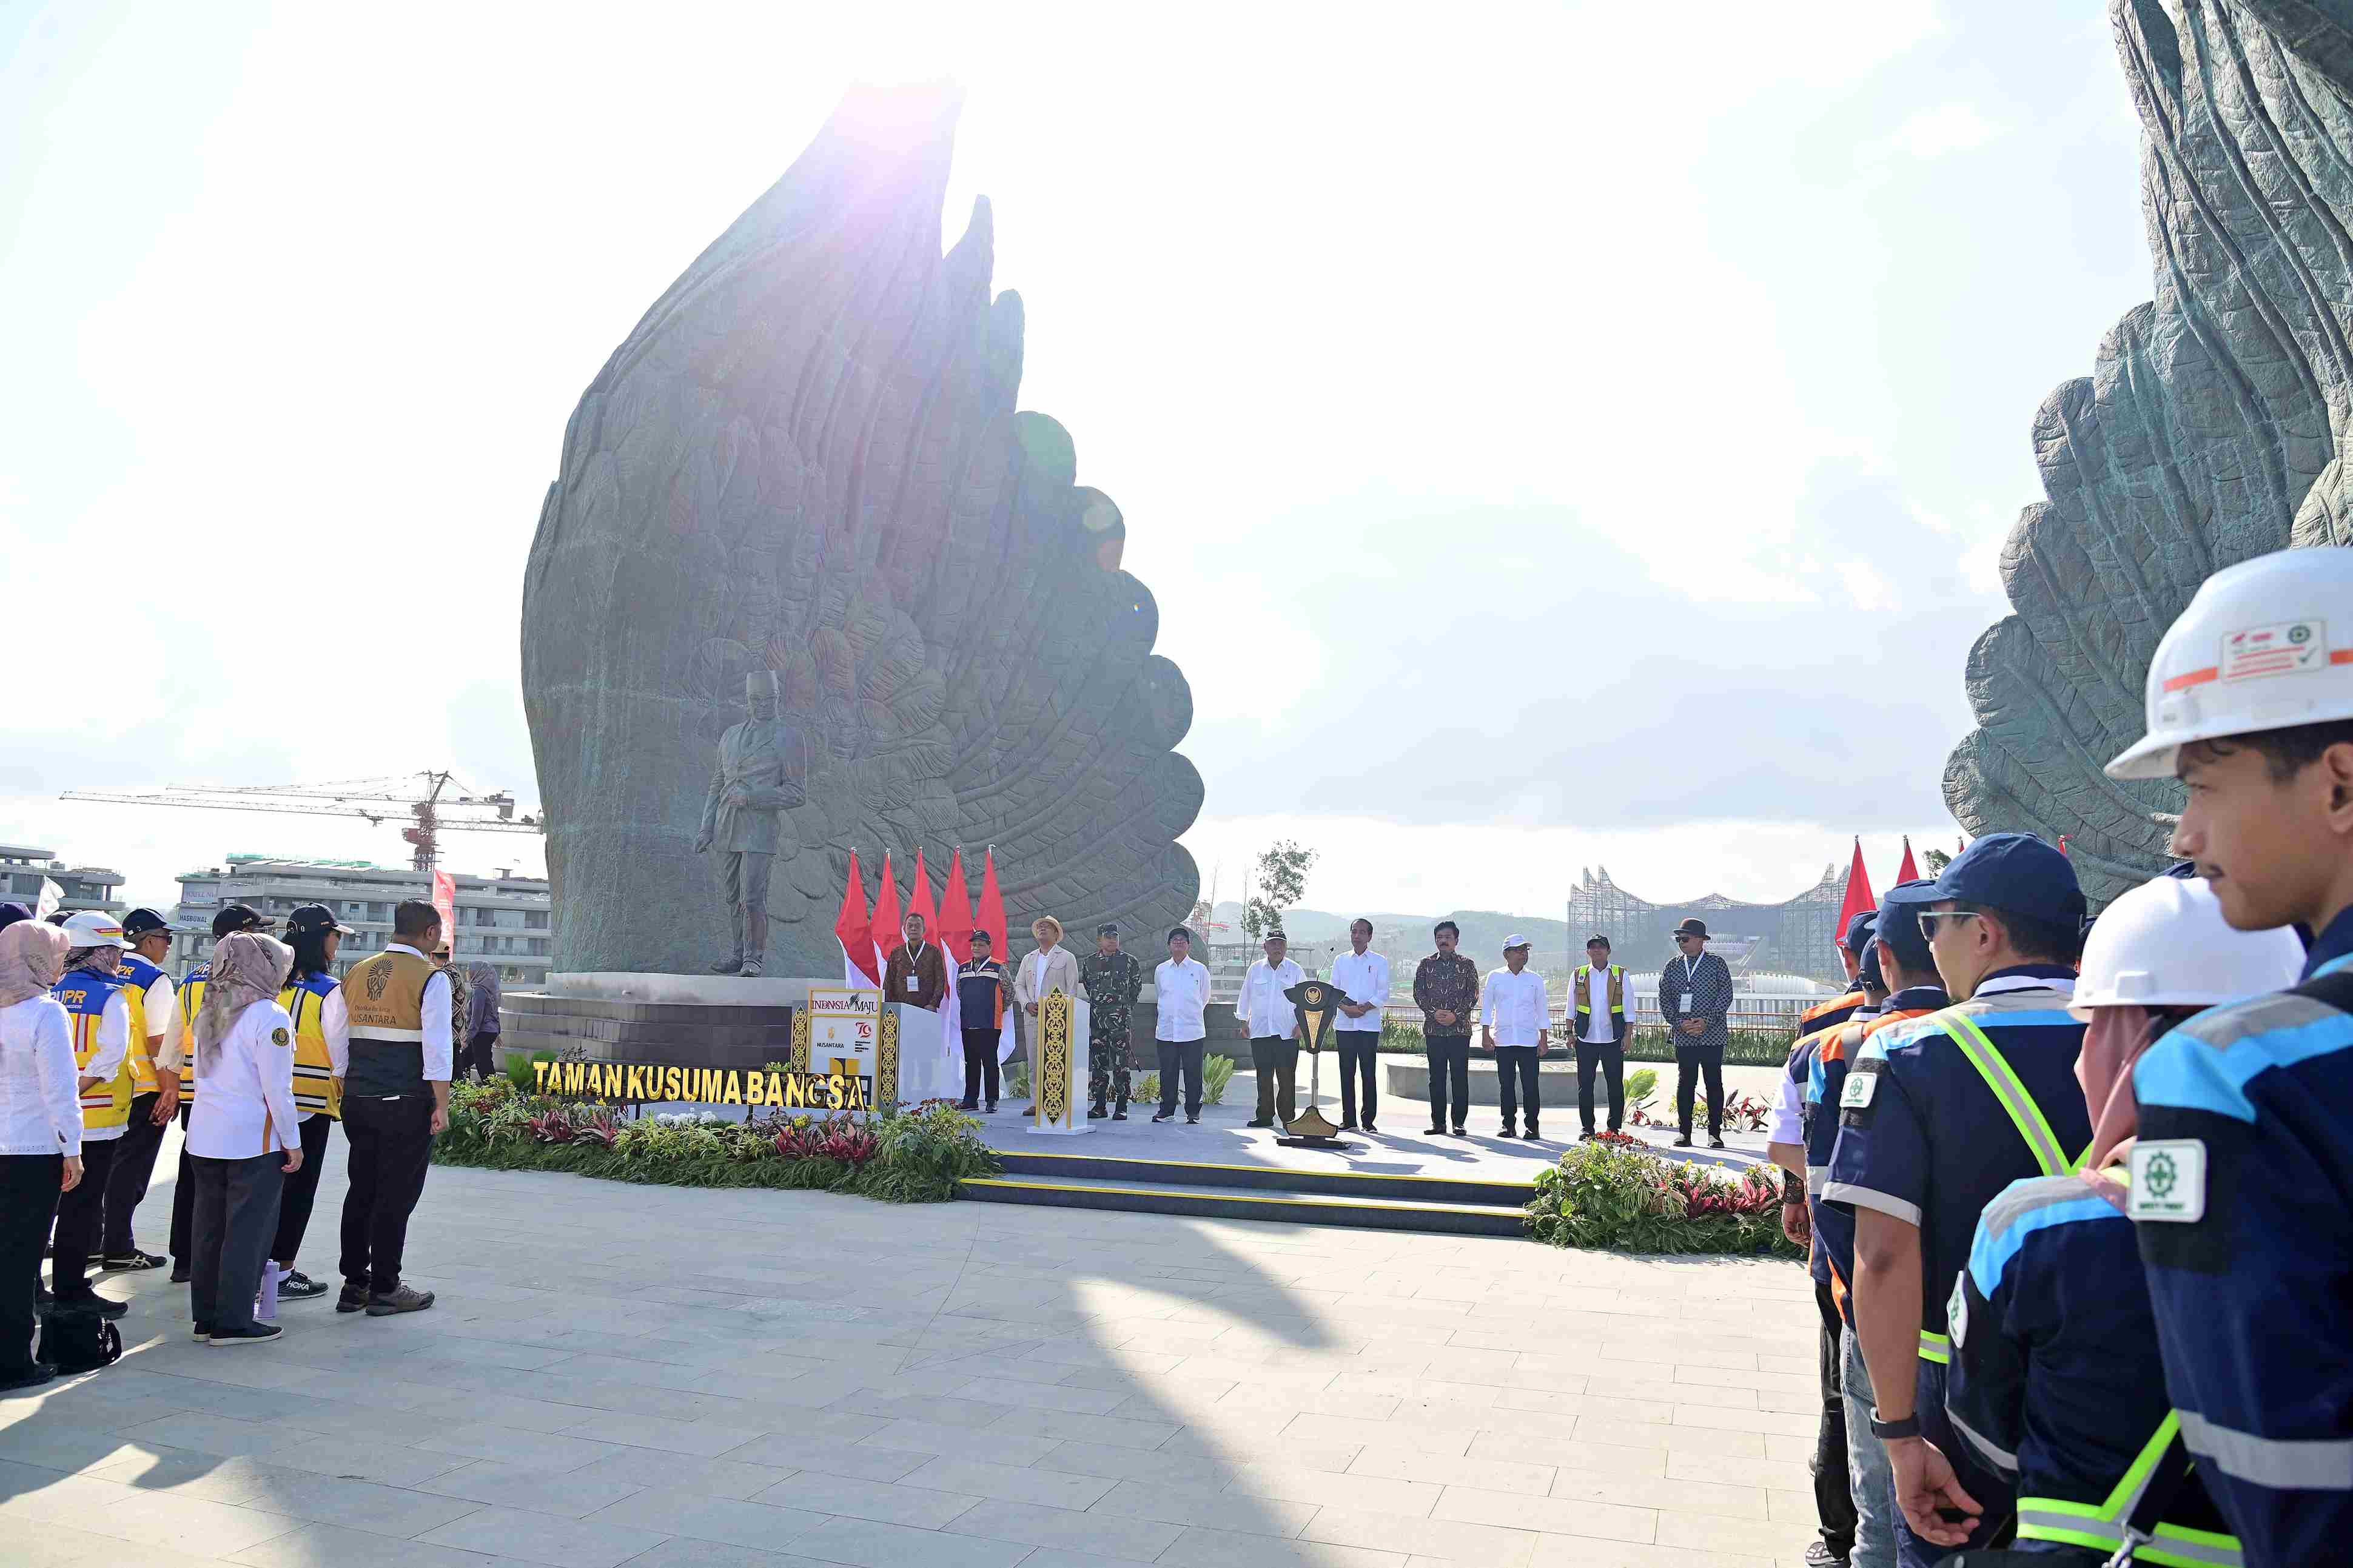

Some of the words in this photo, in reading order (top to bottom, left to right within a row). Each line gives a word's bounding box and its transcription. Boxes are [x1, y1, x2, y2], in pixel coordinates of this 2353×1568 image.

[116, 965, 136, 976] PR
[854, 1000, 878, 1014] MAJU
[747, 1070, 865, 1111] BANGSA
[286, 1280, 310, 1291] HOKA
